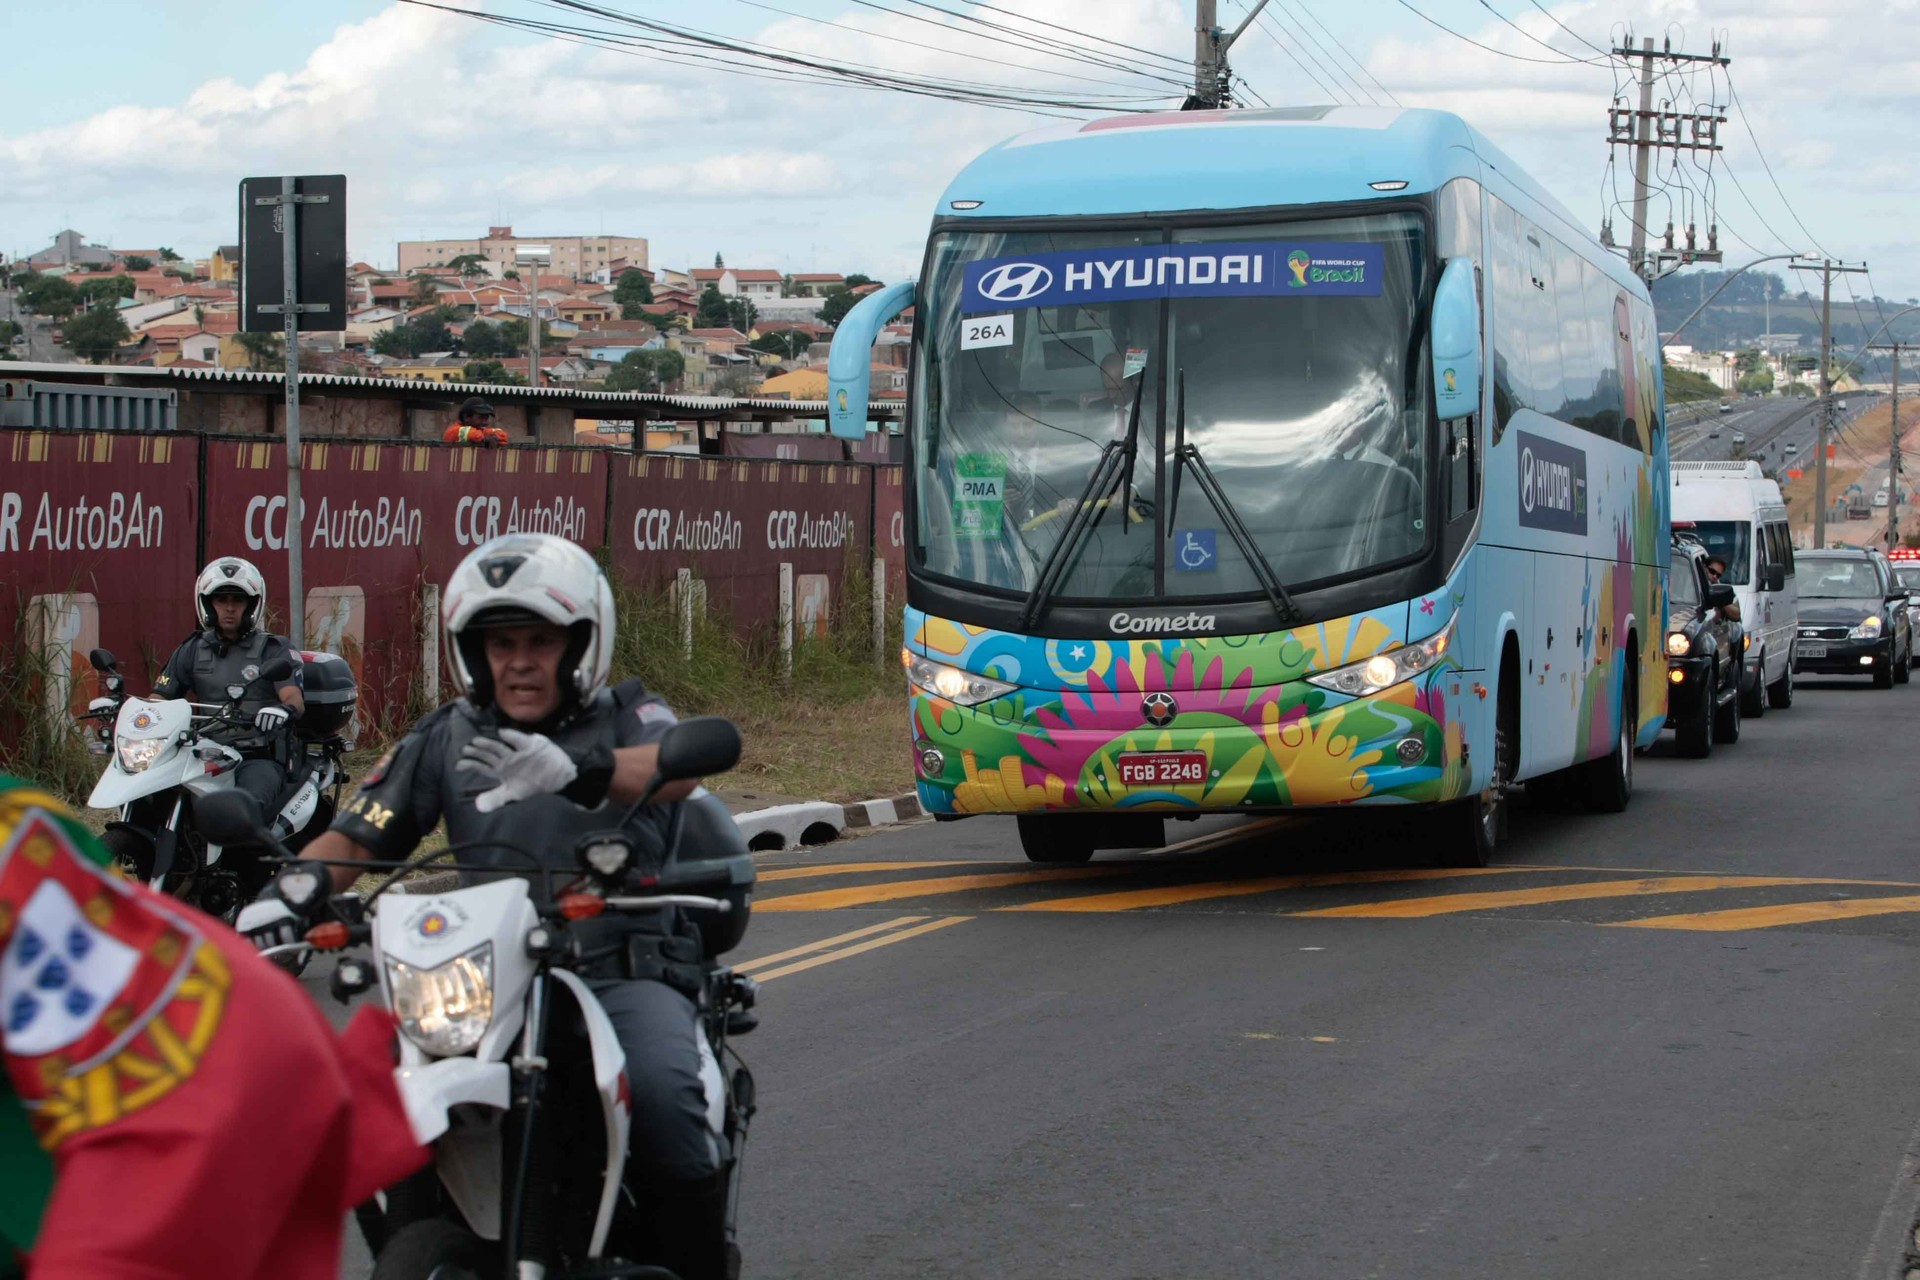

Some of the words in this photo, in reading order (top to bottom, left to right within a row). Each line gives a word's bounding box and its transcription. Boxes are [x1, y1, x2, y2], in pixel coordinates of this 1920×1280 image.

[1064, 254, 1263, 292] HYUNDAI
[1310, 266, 1365, 283] Brasil
[968, 322, 1007, 342] 26A
[962, 482, 996, 496] PMA
[1536, 458, 1571, 512] HYUNDAI
[29, 491, 164, 551] AutoBAn
[309, 496, 423, 550] AutoBAn
[633, 507, 670, 551] CCR
[672, 509, 742, 551] AutoBAn
[766, 509, 797, 550] CCR
[1109, 611, 1216, 634] Cometa
[1123, 764, 1155, 781] FGB
[1160, 763, 1202, 780] 2248
